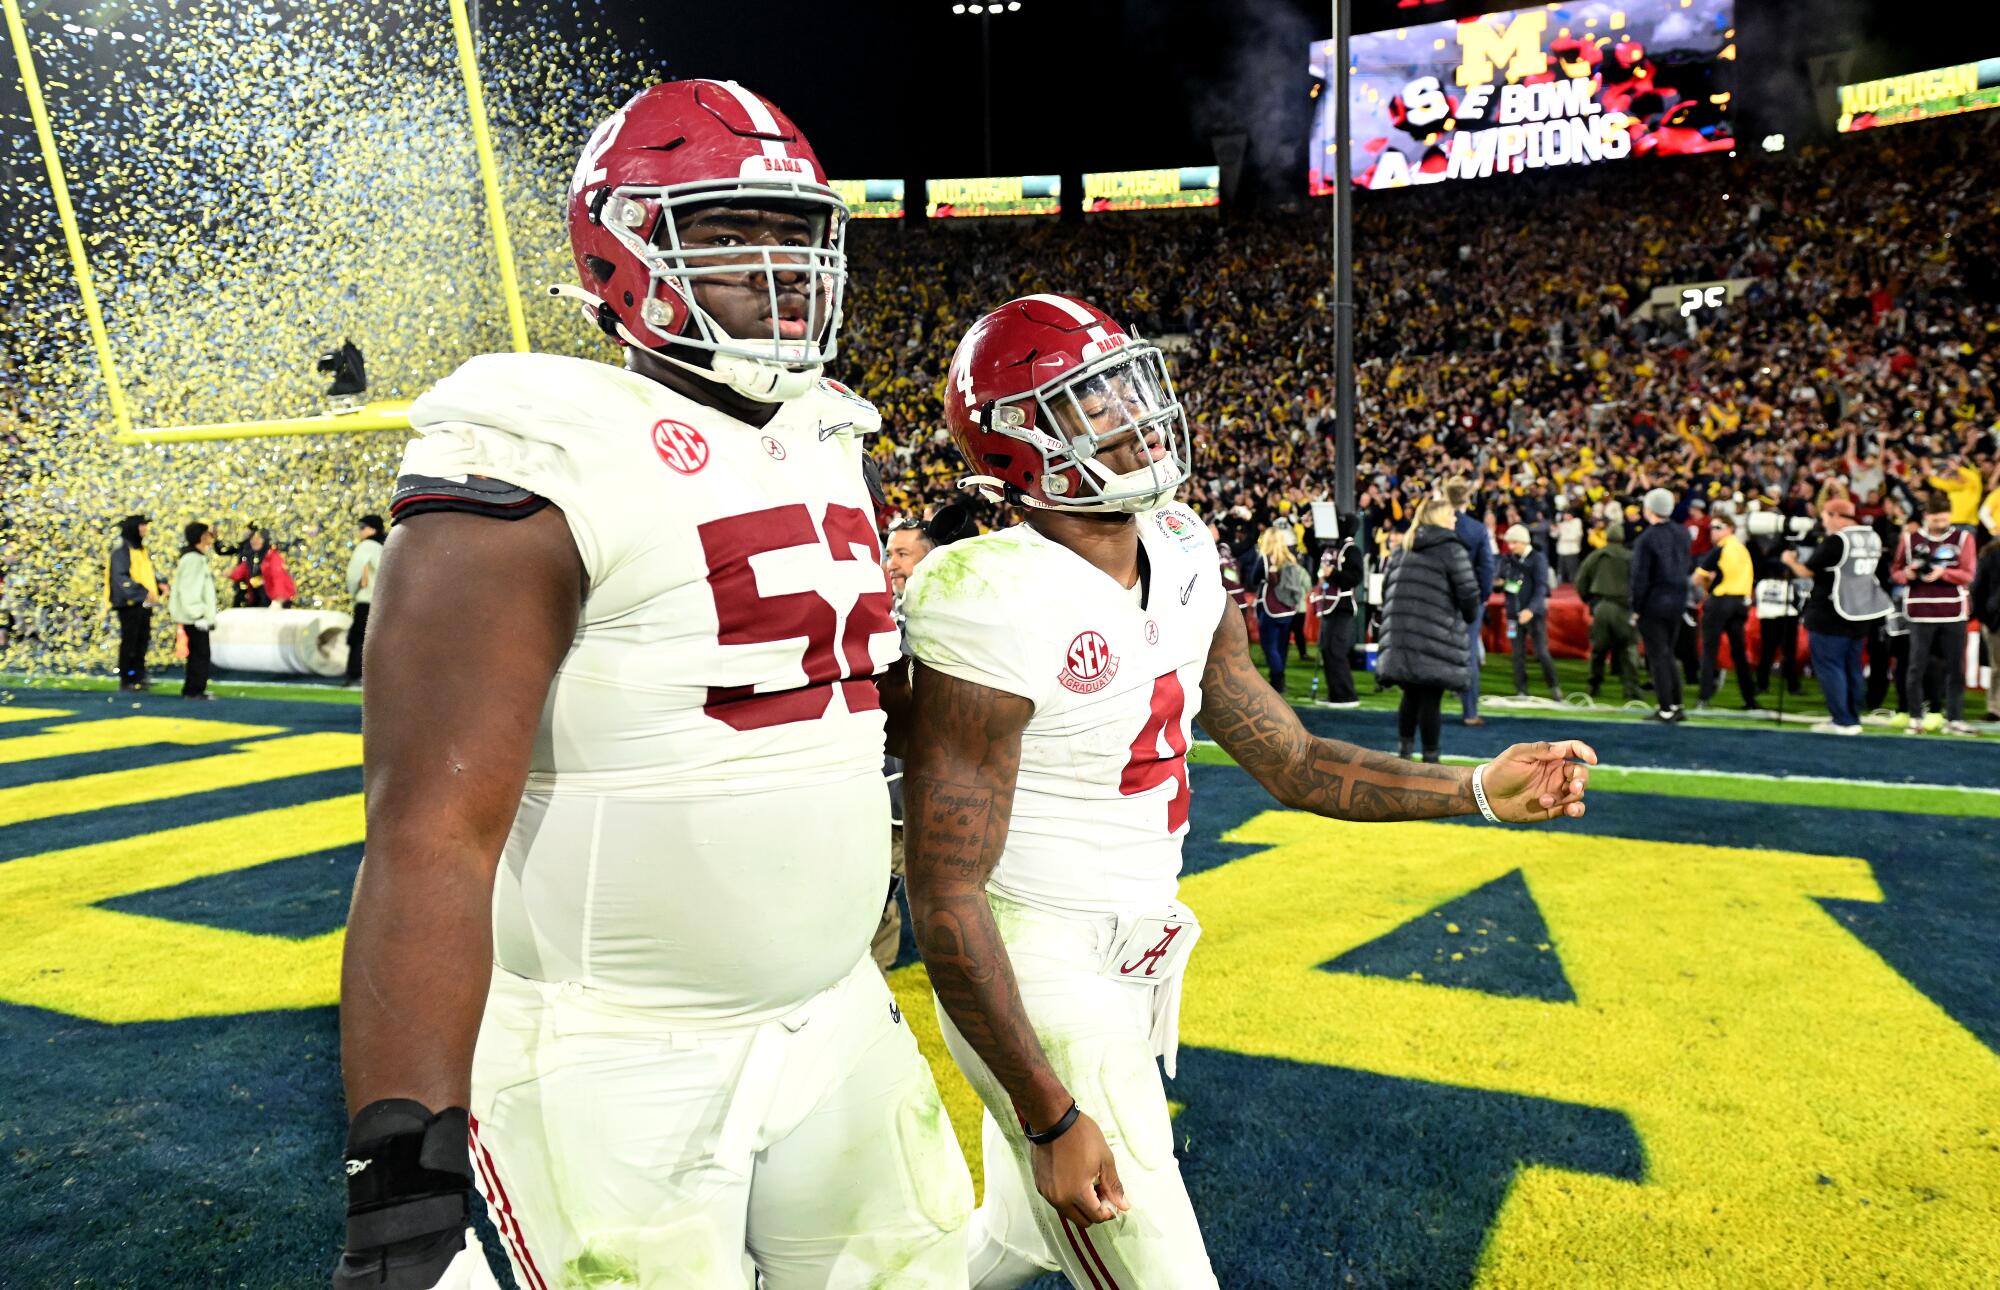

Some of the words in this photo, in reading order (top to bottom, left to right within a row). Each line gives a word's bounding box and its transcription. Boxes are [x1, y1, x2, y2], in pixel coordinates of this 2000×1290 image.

[1456, 10, 1549, 87] M
[1499, 77, 1601, 124] BOWL
[1842, 62, 1979, 114] MICHIGAN
[763, 158, 803, 174] BAMA
[928, 176, 1022, 203] MICHIGAN
[1085, 168, 1180, 198] MICHIGAN
[1096, 334, 1125, 353] BAMA
[654, 420, 708, 473] SEC
[697, 501, 898, 732] 52
[1068, 632, 1109, 679] SEC
[1065, 667, 1116, 693] GRADUATE
[1119, 669, 1191, 835] 4
[1474, 783, 1489, 812] HUMBLE
[1120, 924, 1182, 976] A
